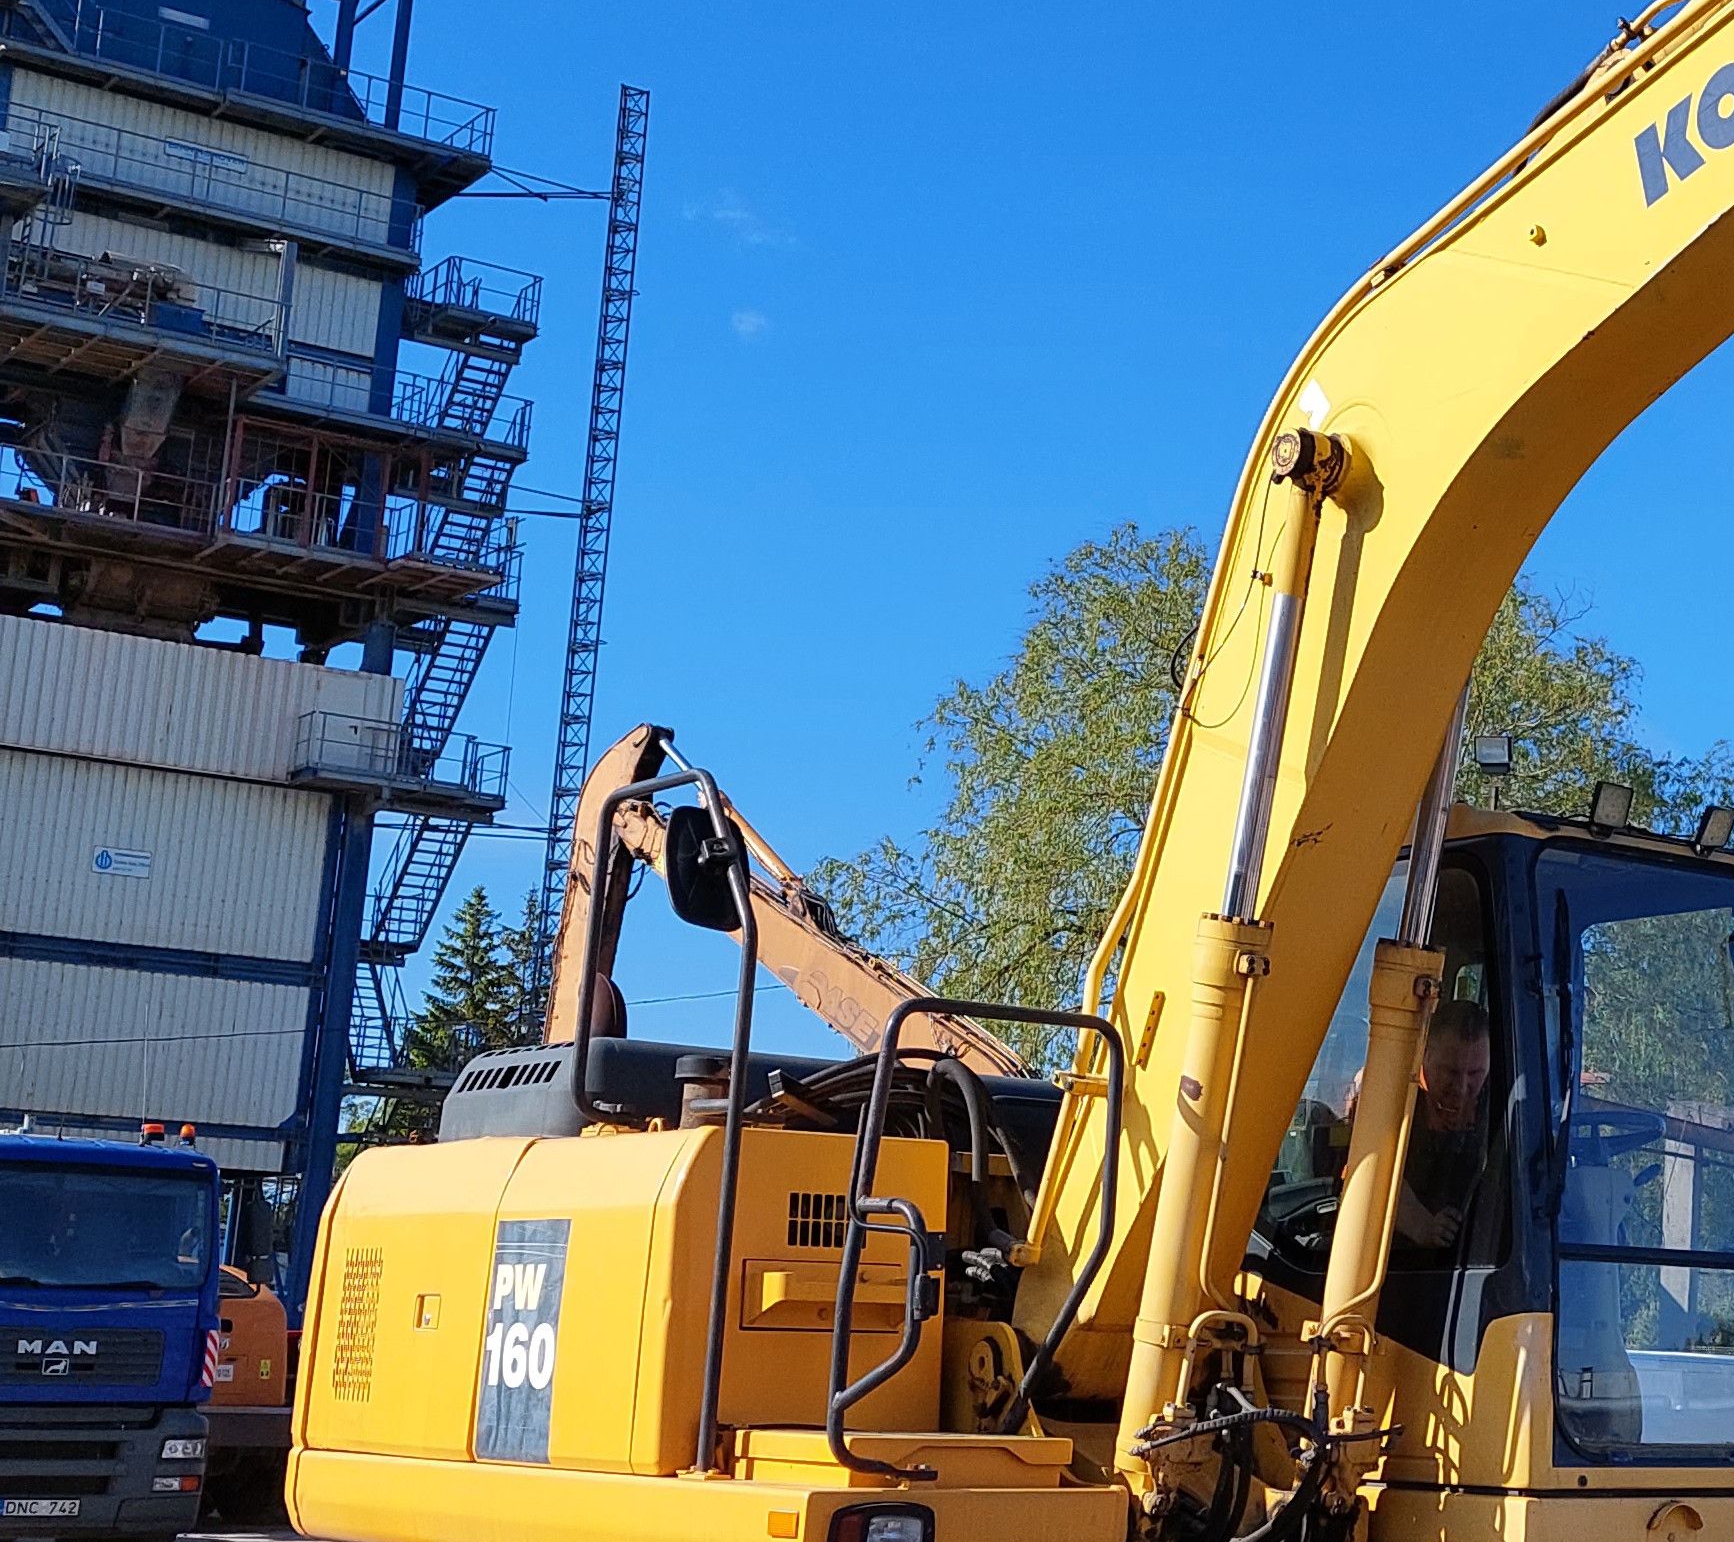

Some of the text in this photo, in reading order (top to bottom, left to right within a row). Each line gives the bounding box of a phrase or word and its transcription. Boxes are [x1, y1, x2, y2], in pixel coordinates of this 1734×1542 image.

[493, 1263, 547, 1310] PW
[17, 1339, 97, 1355] MAN
[486, 1322, 555, 1390] 160
[5, 1501, 77, 1514] DNC 742
